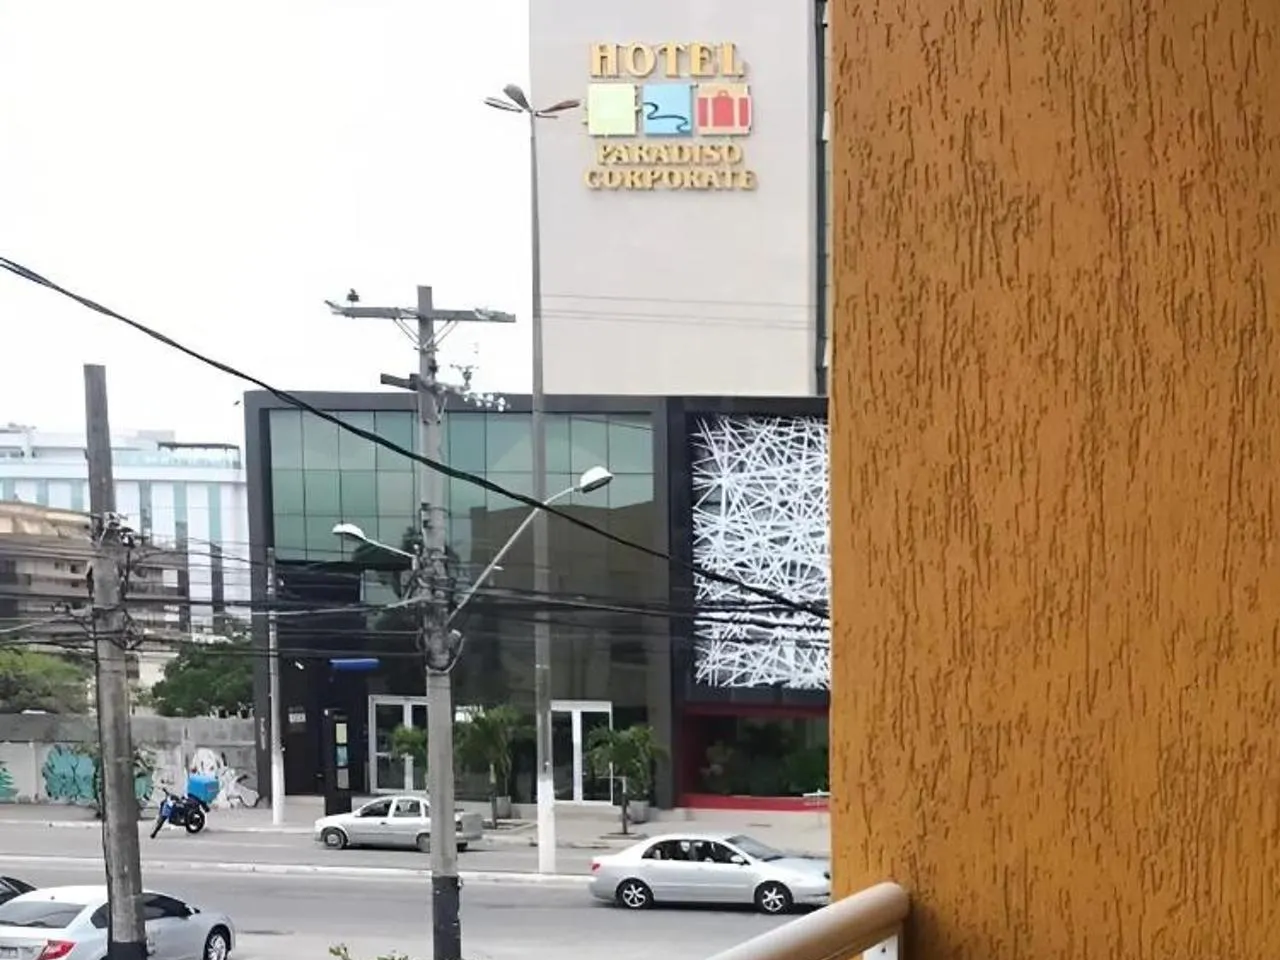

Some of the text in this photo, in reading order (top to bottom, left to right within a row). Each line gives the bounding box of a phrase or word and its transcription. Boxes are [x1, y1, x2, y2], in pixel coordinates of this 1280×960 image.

[589, 42, 746, 78] HOTEL
[596, 143, 743, 166] PARADISO
[585, 168, 758, 192] CORPORATE
